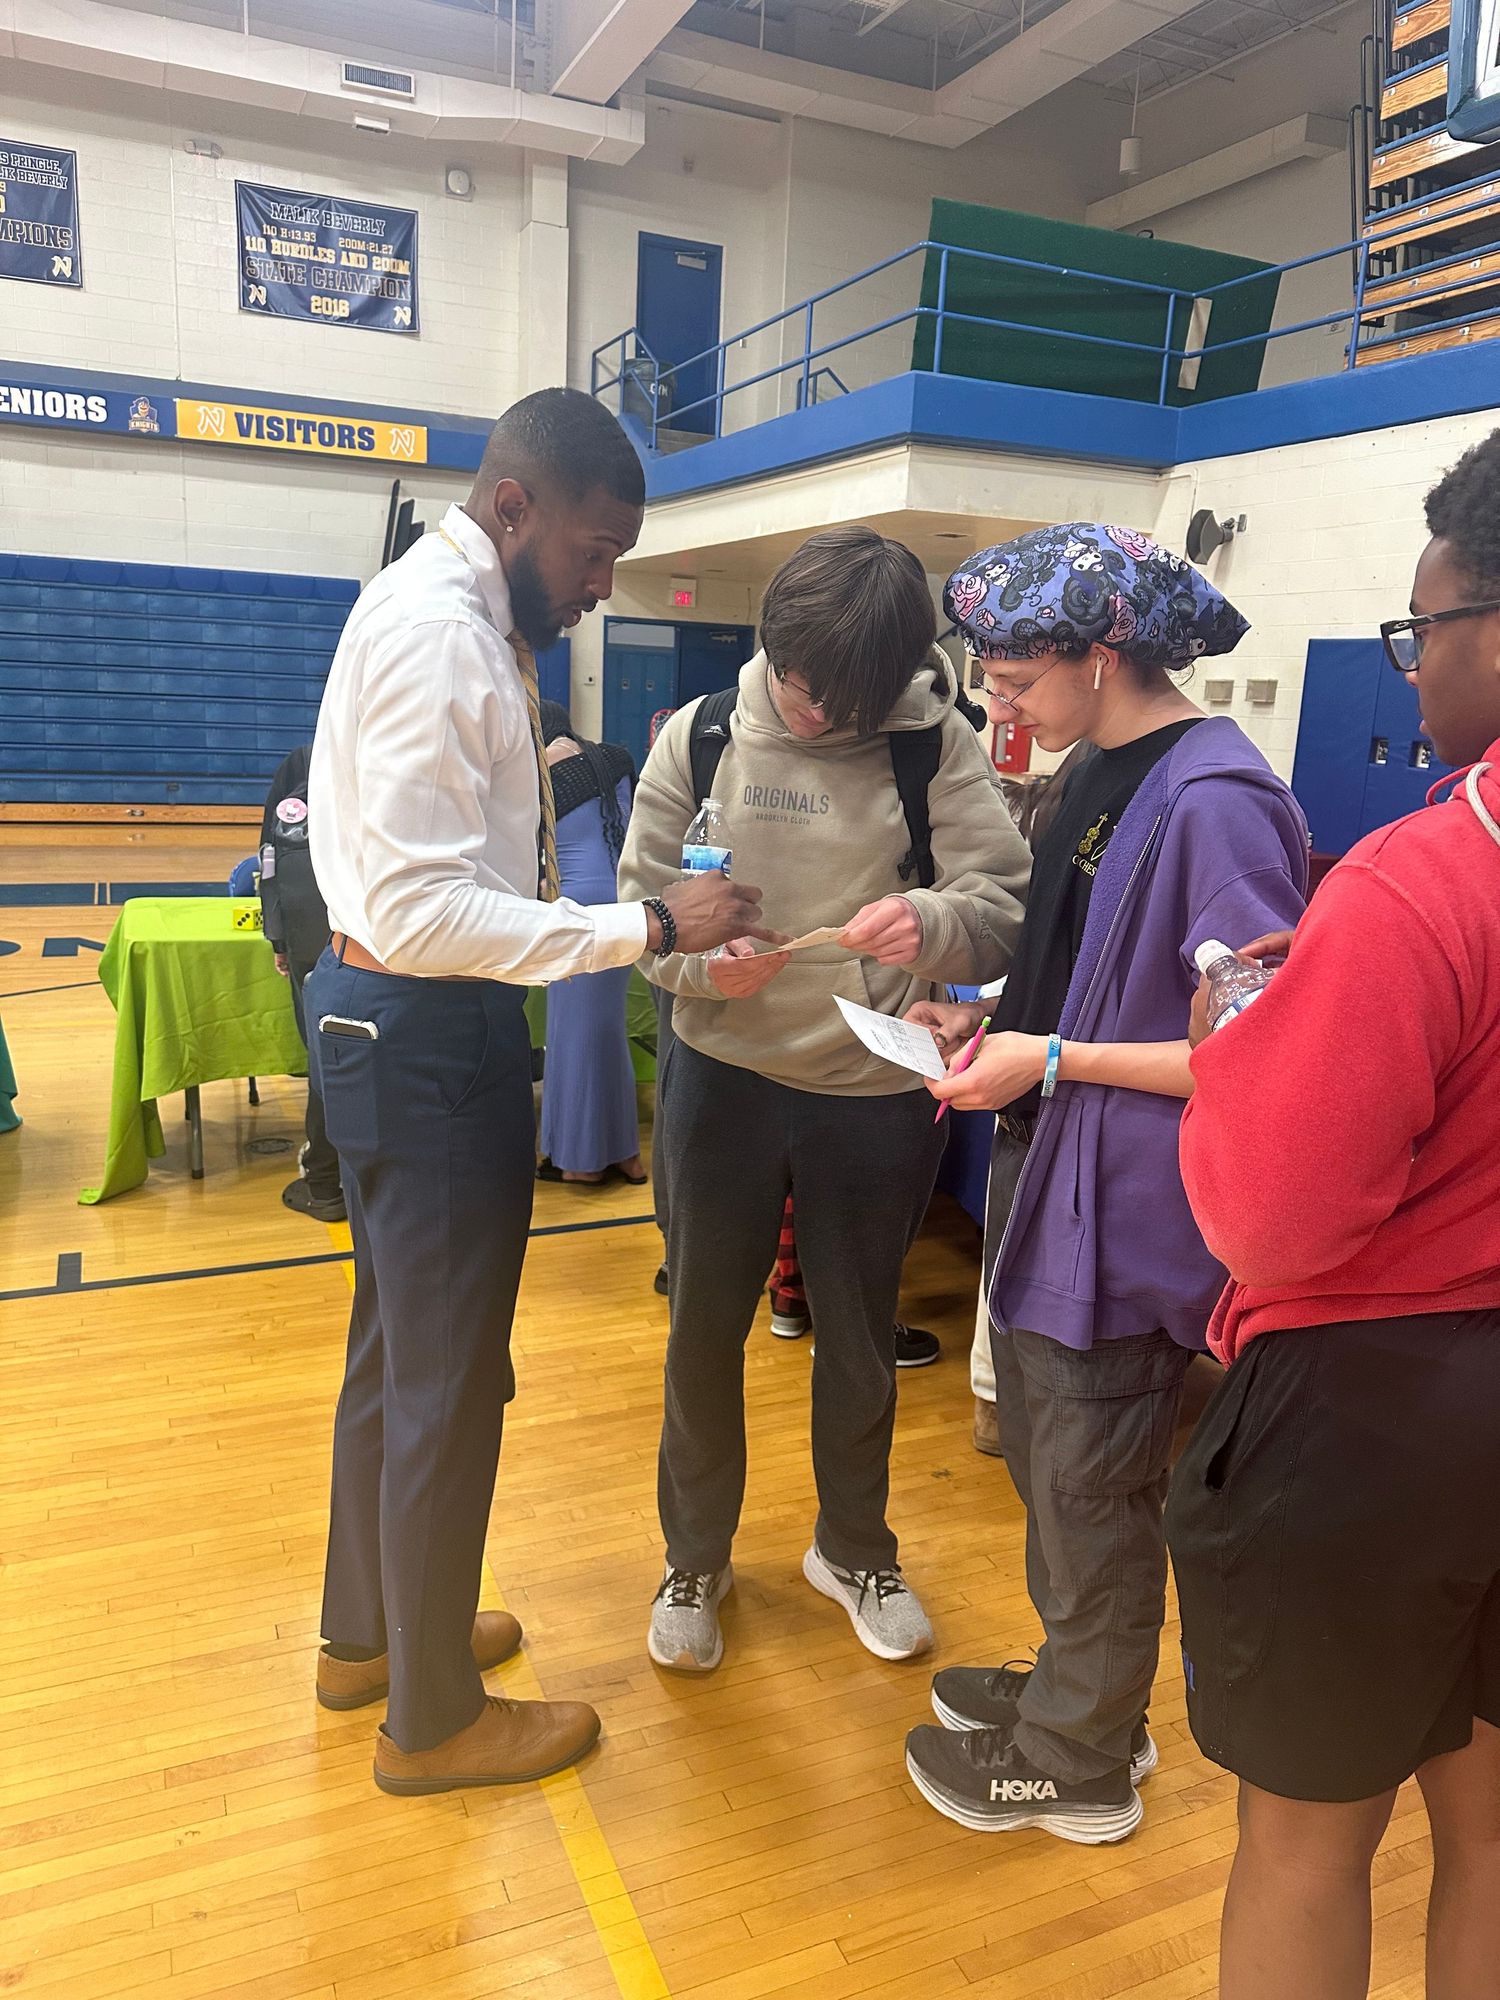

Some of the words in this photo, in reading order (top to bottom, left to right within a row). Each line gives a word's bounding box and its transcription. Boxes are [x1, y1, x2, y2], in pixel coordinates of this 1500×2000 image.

[10, 153, 62, 175] PRINGLE,
[17, 169, 68, 189] BEVERLY
[270, 202, 319, 225] MALIK
[322, 210, 386, 236] BEVERLY
[262, 223, 277, 236] 110
[280, 228, 317, 242] H:13.93
[338, 237, 393, 255] 200M:21.27
[245, 235, 267, 253] 110
[271, 238, 336, 264] HURDLES
[340, 251, 368, 269] AND
[372, 255, 411, 275] 200M
[246, 256, 307, 286] STATE
[311, 266, 411, 301] CHAMPION
[234, 411, 375, 451] VISITORS
[743, 785, 830, 815] ORIGINALS
[755, 813, 788, 823] BROOKLYN
[790, 816, 812, 825] CLOTH
[989, 1780, 1058, 1801] HOKA
